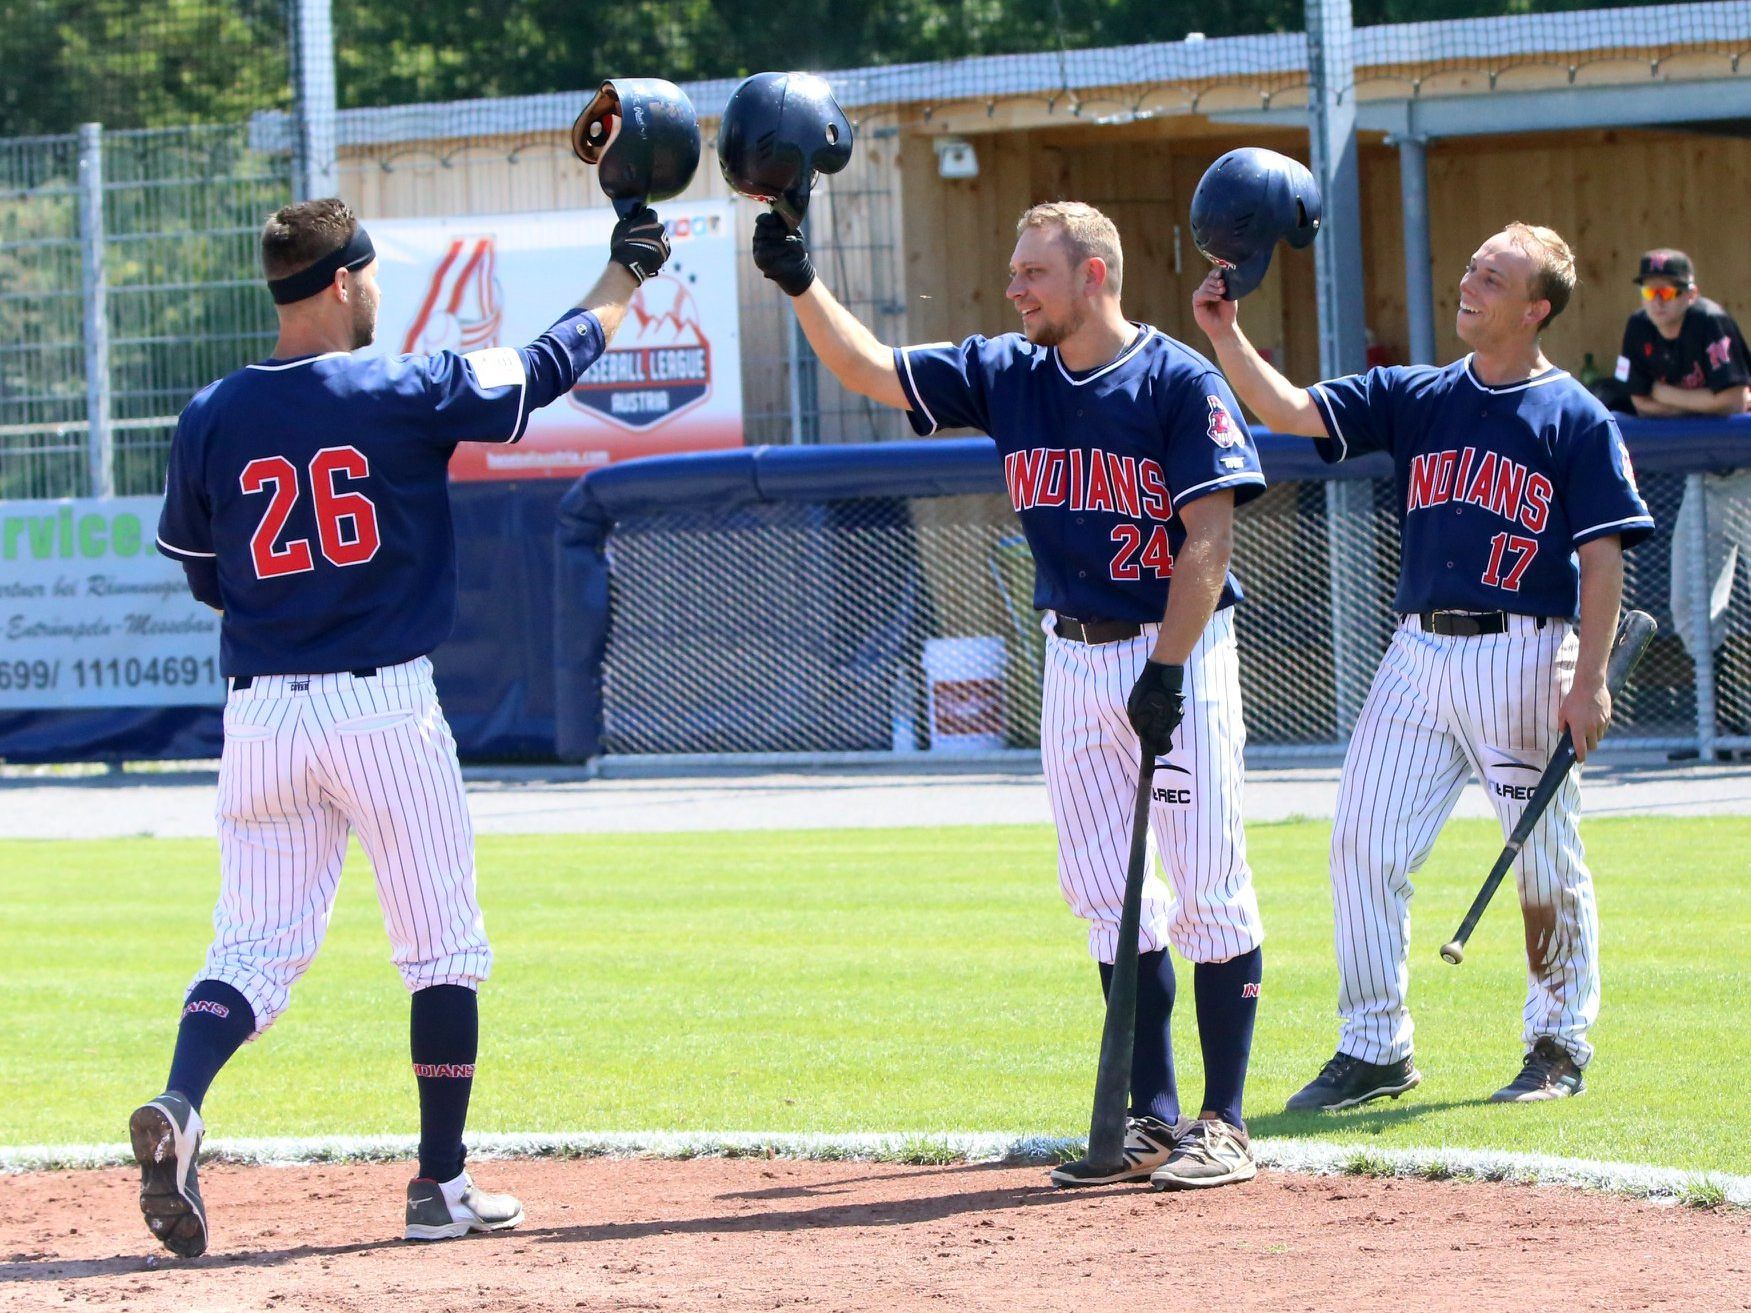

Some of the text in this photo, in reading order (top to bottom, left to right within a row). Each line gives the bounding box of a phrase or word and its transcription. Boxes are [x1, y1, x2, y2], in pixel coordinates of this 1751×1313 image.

[650, 348, 706, 380] LEAGUE
[611, 391, 669, 413] AUSTRIA
[1005, 448, 1173, 522] INDIANS
[239, 445, 381, 579] 26
[1110, 524, 1174, 581] 24
[1481, 532, 1539, 592] 17
[54, 573, 78, 597] bei
[72, 655, 215, 689] 11104691
